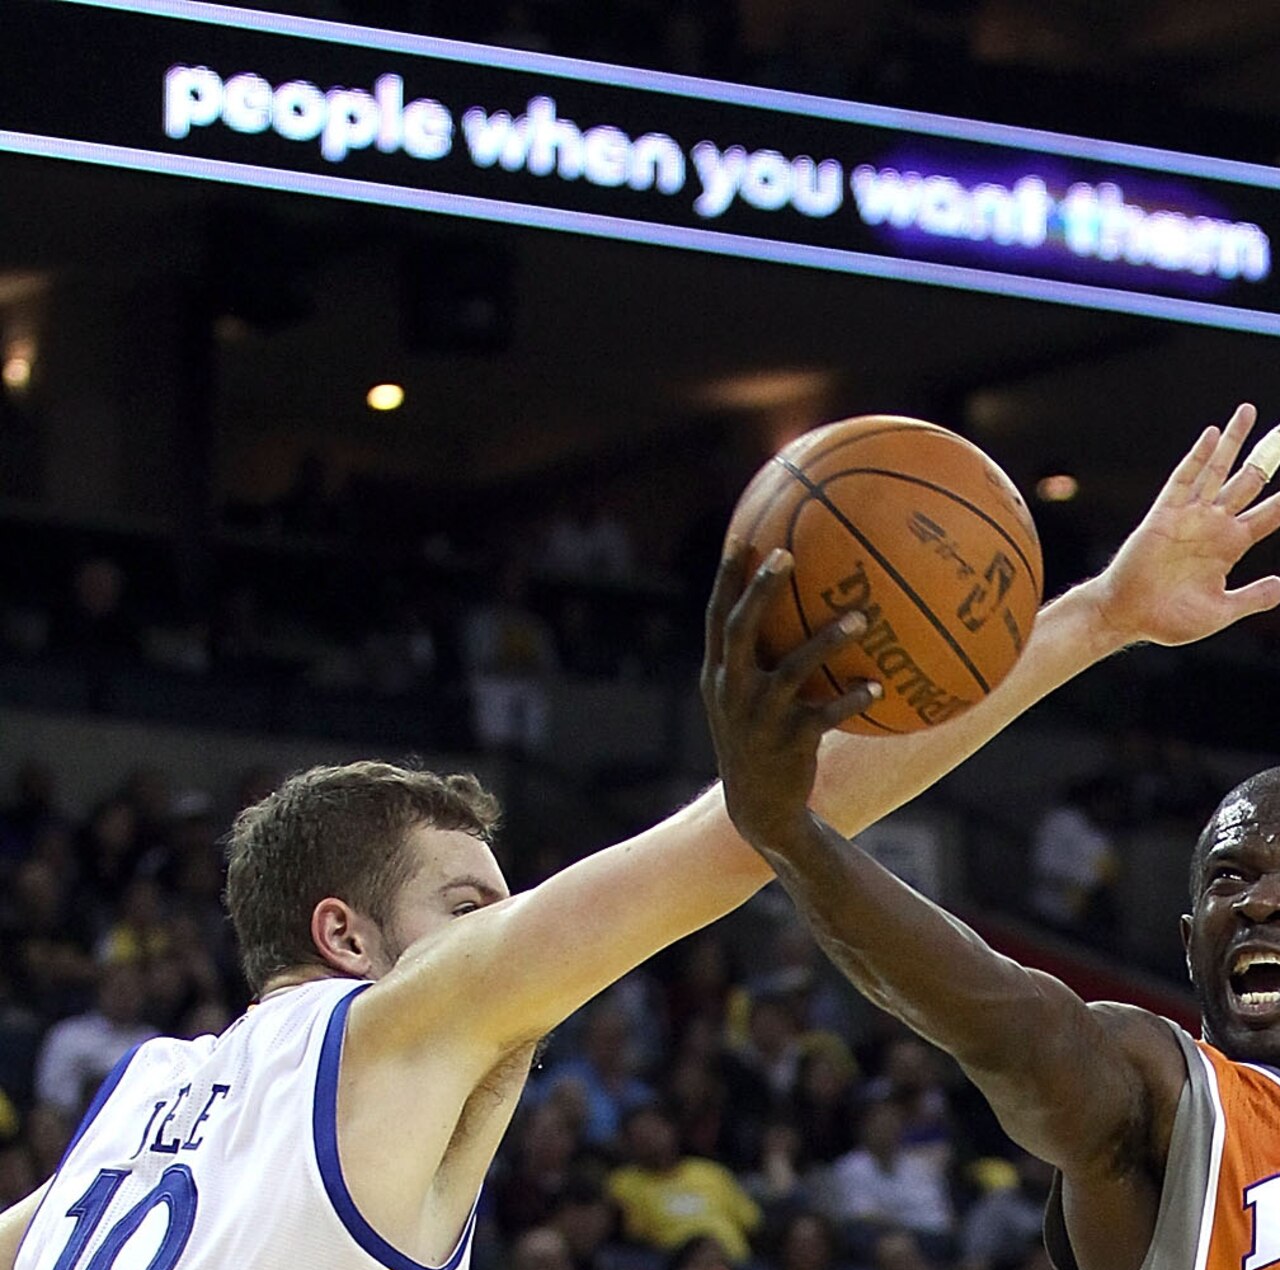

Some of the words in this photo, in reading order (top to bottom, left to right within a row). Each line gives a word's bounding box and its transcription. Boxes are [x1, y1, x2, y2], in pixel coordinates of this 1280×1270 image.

[164, 65, 453, 162] people
[462, 96, 687, 195] when
[693, 144, 844, 218] you
[851, 160, 1049, 246] want
[1054, 182, 1271, 281] them
[821, 560, 976, 726] PALDING
